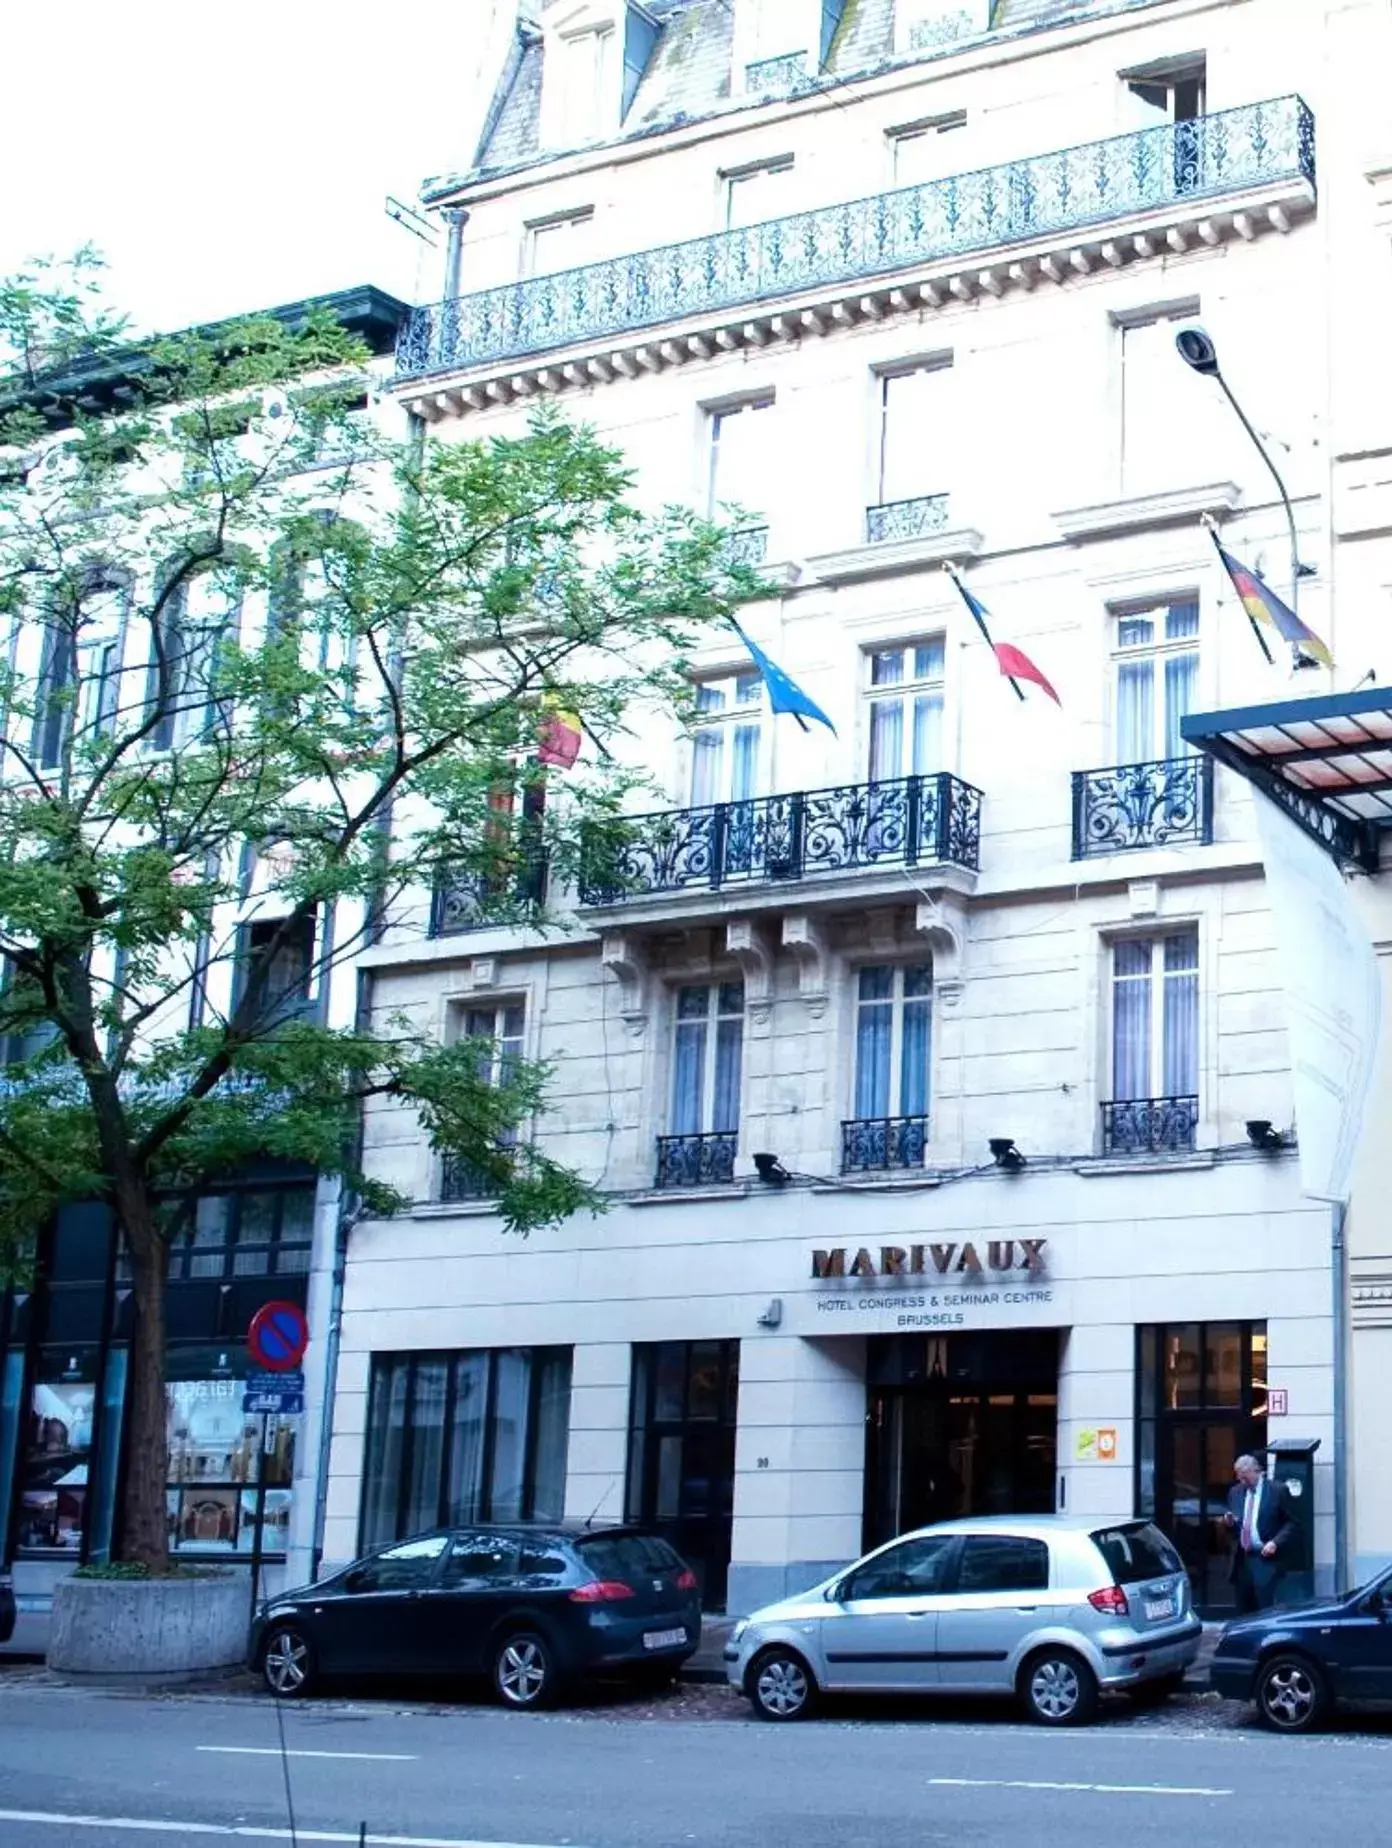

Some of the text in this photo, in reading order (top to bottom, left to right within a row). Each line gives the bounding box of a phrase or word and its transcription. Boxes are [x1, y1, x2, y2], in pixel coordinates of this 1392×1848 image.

[811, 1239, 1047, 1279] MARIVAUX
[817, 1290, 1053, 1311] HOTEL CONGRESS & SEMINAR CENTRE
[897, 1313, 964, 1326] BRUSSELS
[1272, 1394, 1283, 1410] H
